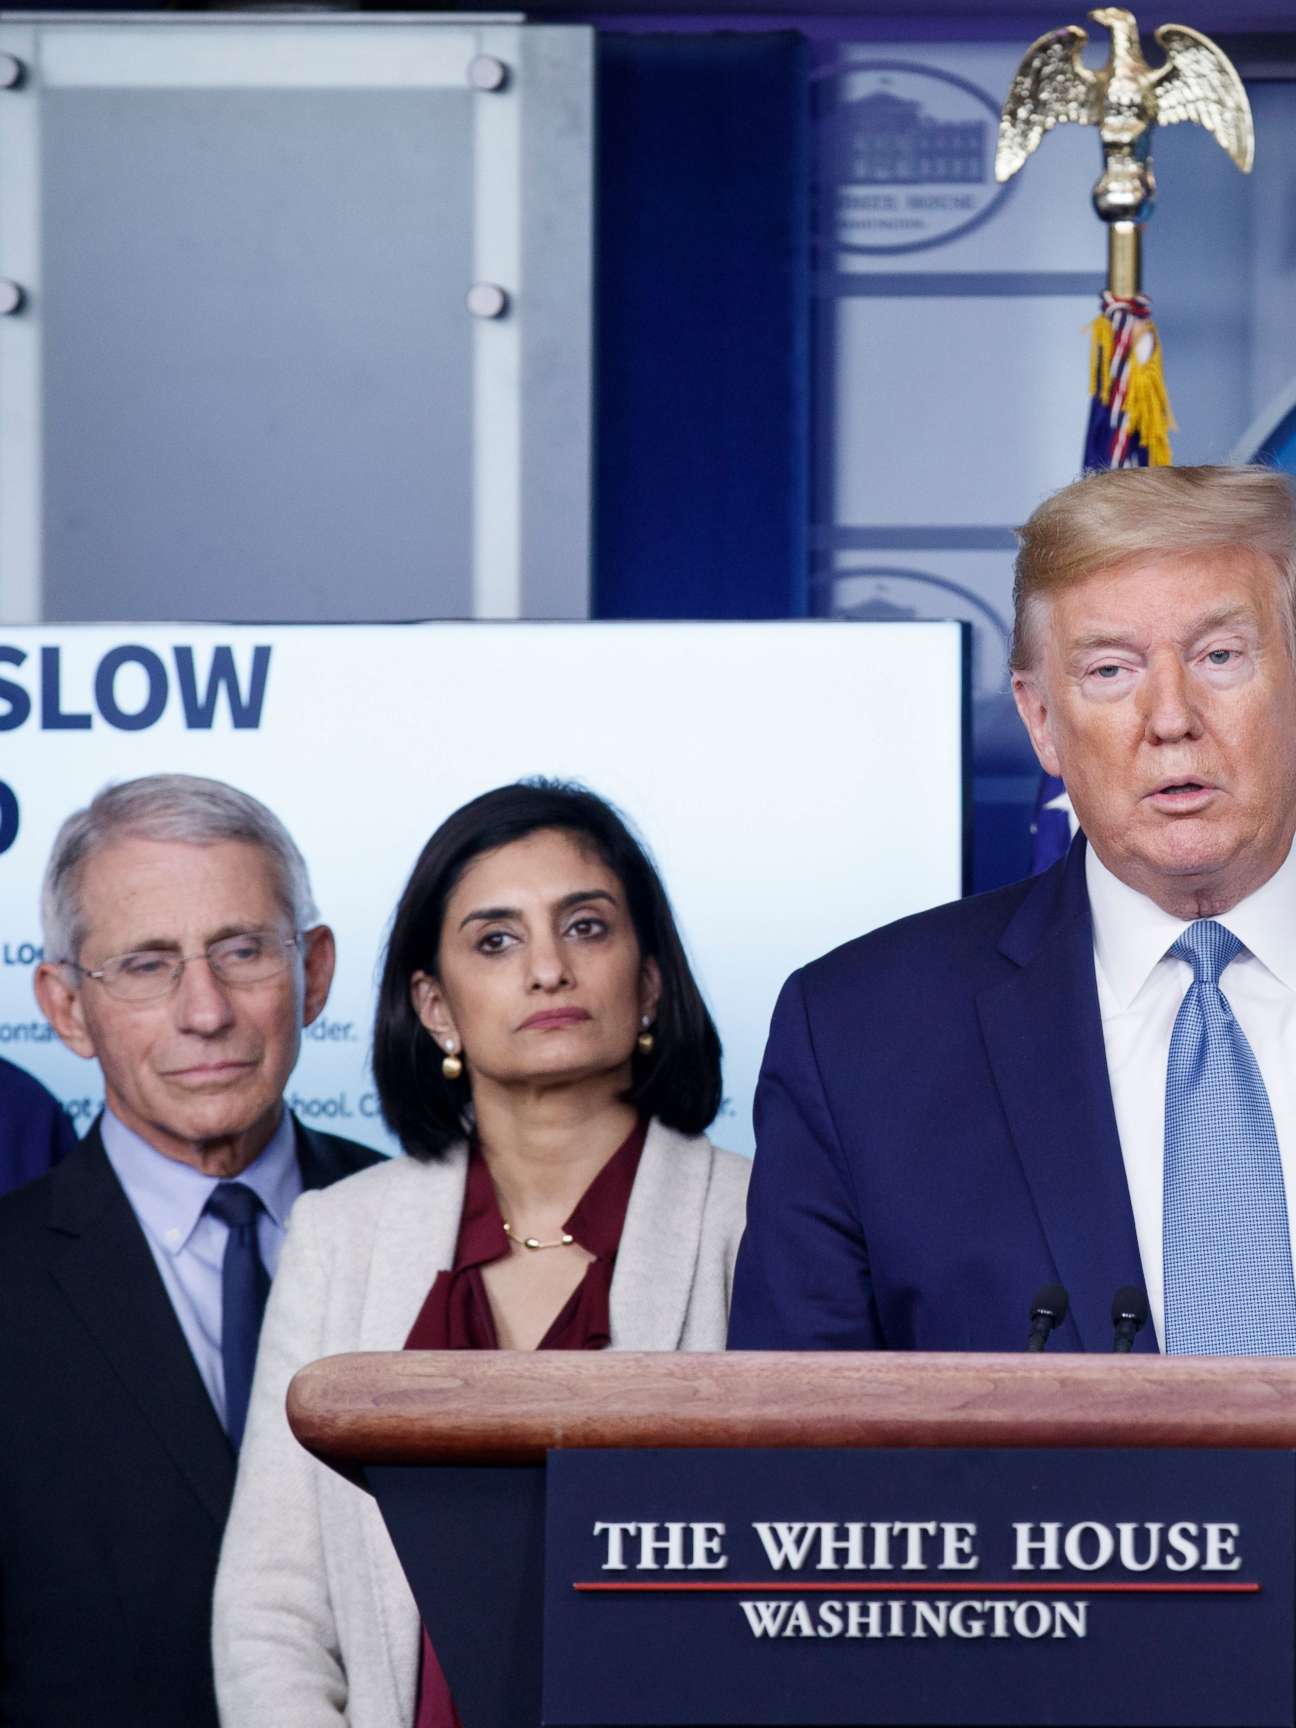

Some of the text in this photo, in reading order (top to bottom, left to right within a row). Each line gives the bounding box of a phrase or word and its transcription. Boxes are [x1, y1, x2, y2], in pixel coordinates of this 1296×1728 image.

[0, 644, 272, 731] SLOW
[593, 1521, 1242, 1571] THE WHITE HOUSE
[740, 1600, 1088, 1637] WASHINGTON
